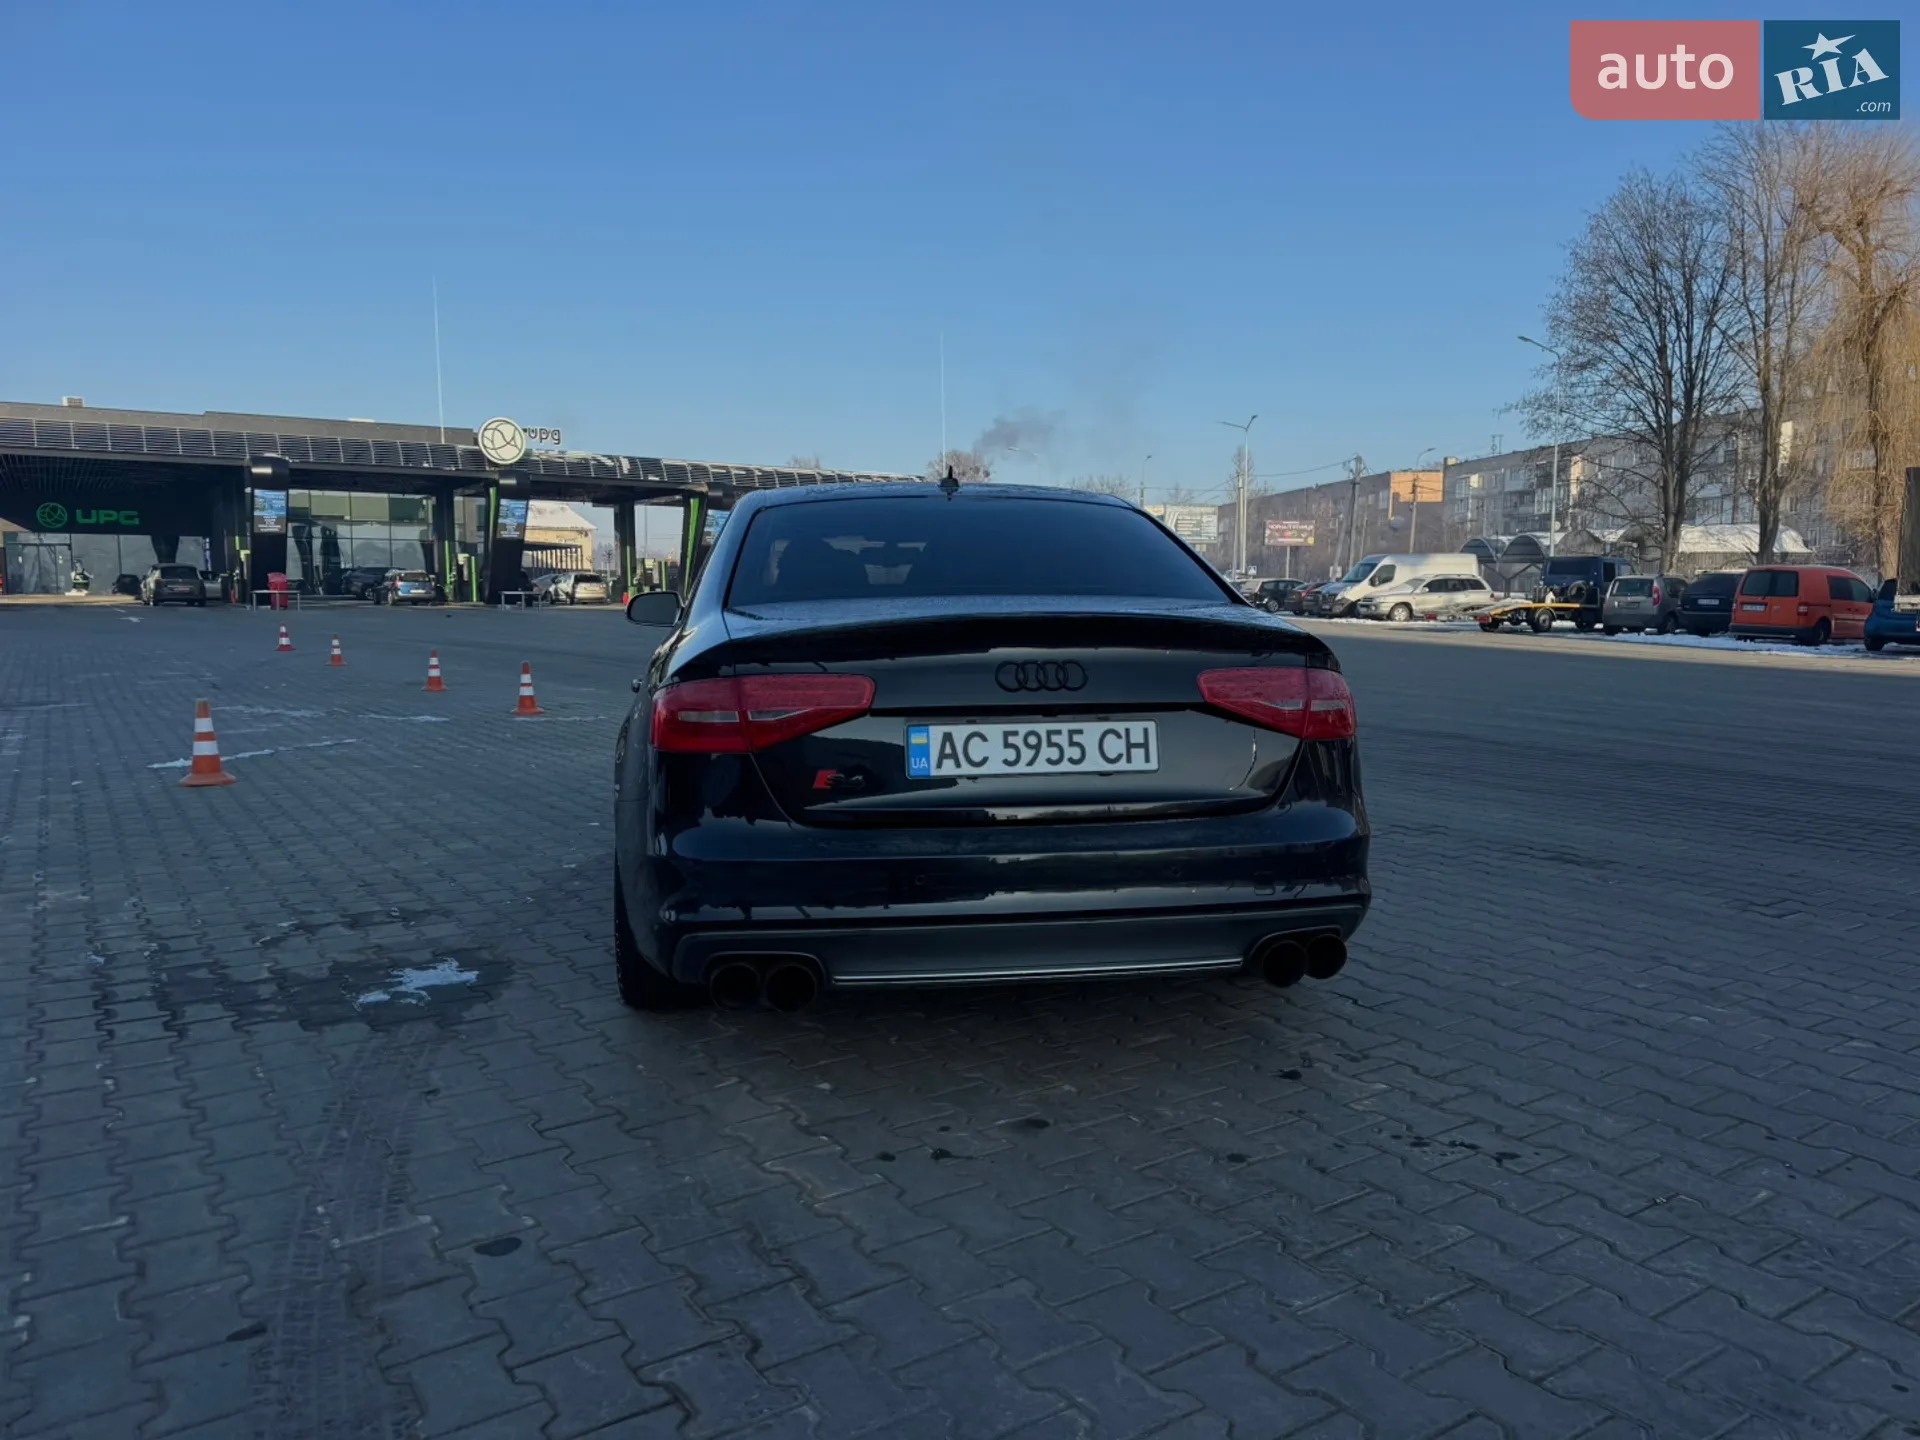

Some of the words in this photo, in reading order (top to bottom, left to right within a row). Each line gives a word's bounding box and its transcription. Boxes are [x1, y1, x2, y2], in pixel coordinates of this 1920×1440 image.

[527, 426, 561, 445] upg
[76, 509, 140, 526] UPG
[935, 729, 990, 770] AC
[1001, 728, 1087, 768] 5955
[1097, 726, 1152, 765] CH
[910, 756, 929, 770] UA
